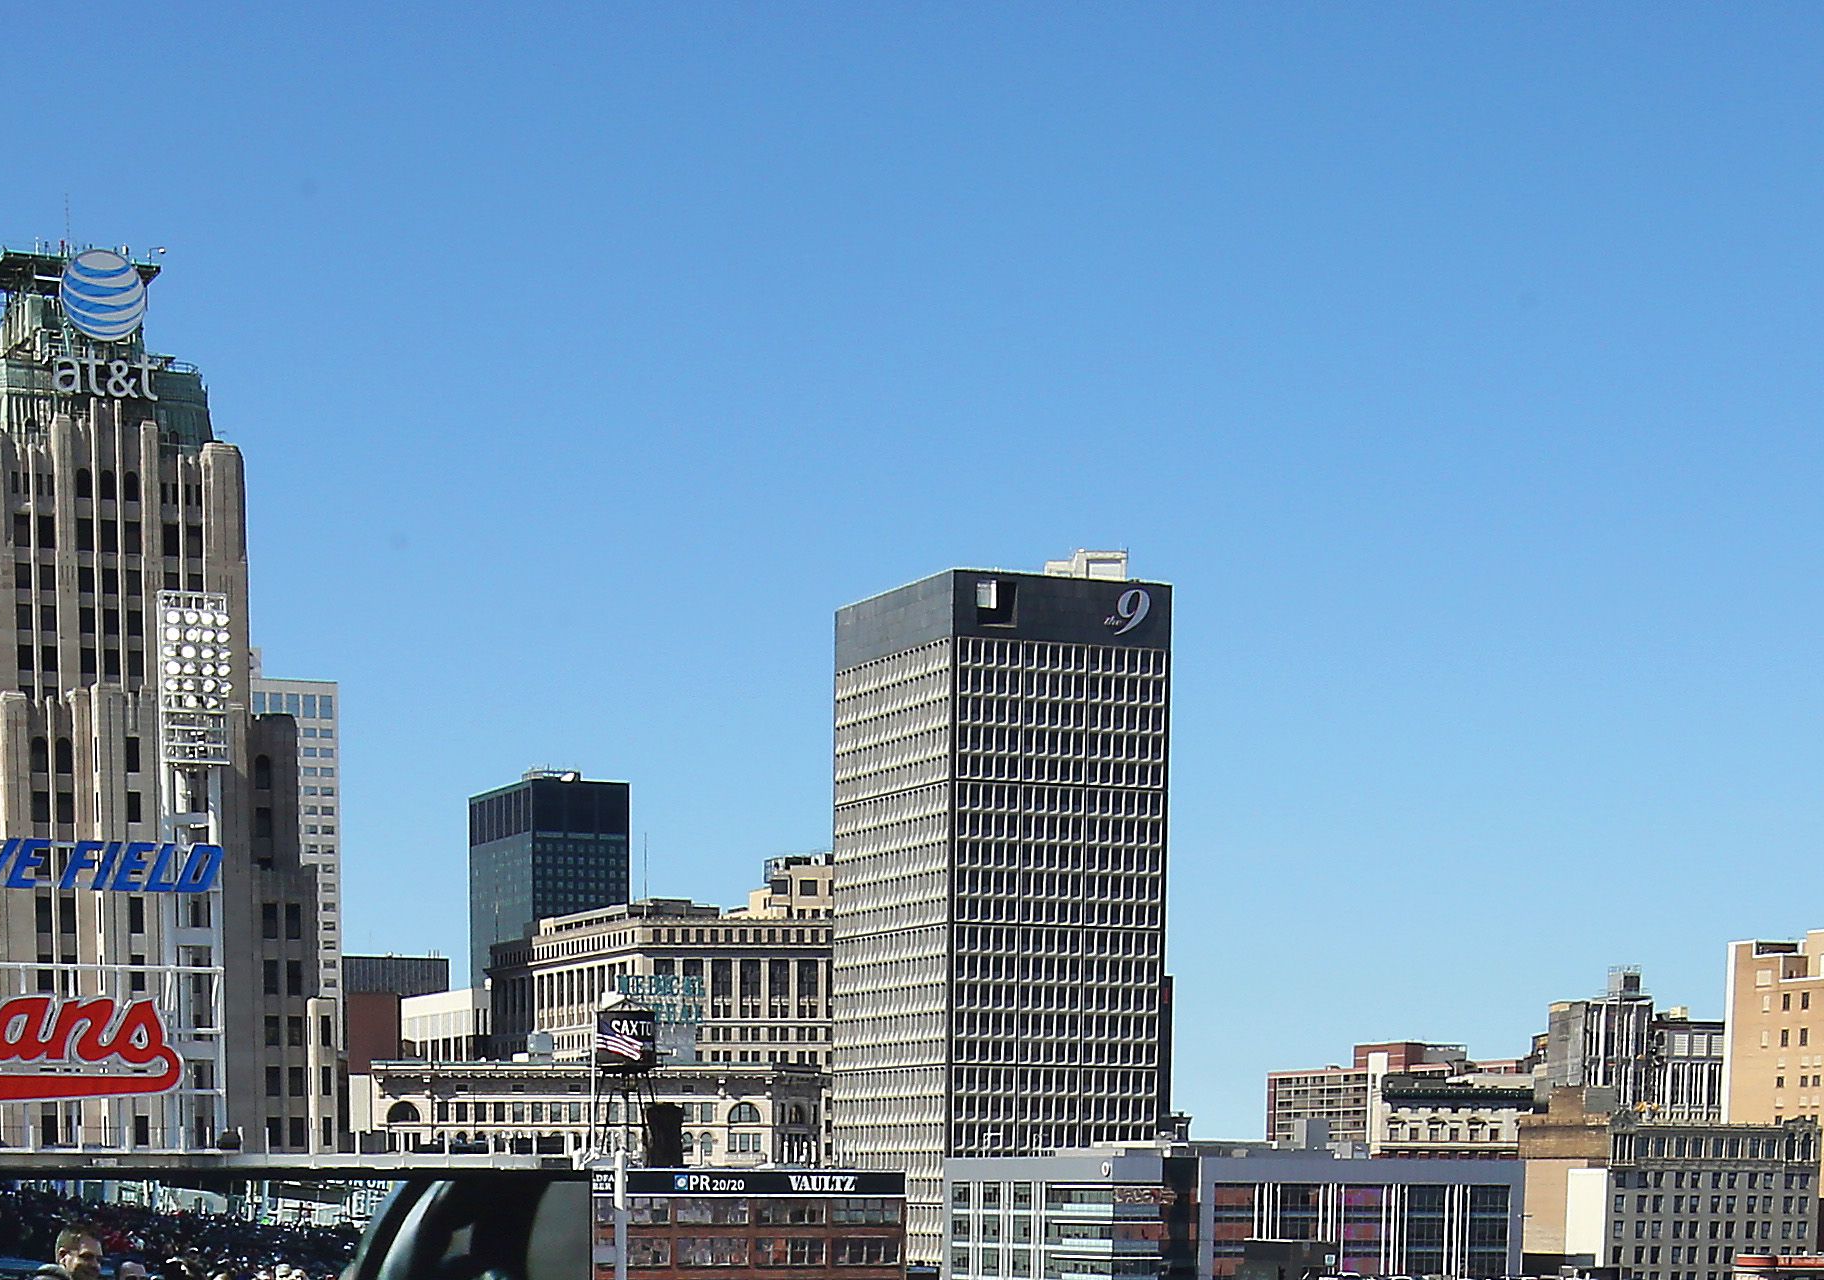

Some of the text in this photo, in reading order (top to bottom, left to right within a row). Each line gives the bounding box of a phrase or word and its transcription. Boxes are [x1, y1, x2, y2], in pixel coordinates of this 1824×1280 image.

[52, 353, 158, 401] at&t
[1114, 589, 1150, 635] 9
[61, 840, 224, 894] FIELD
[689, 1174, 745, 1192] PR 20/20
[788, 1174, 857, 1192] VAULTZ
